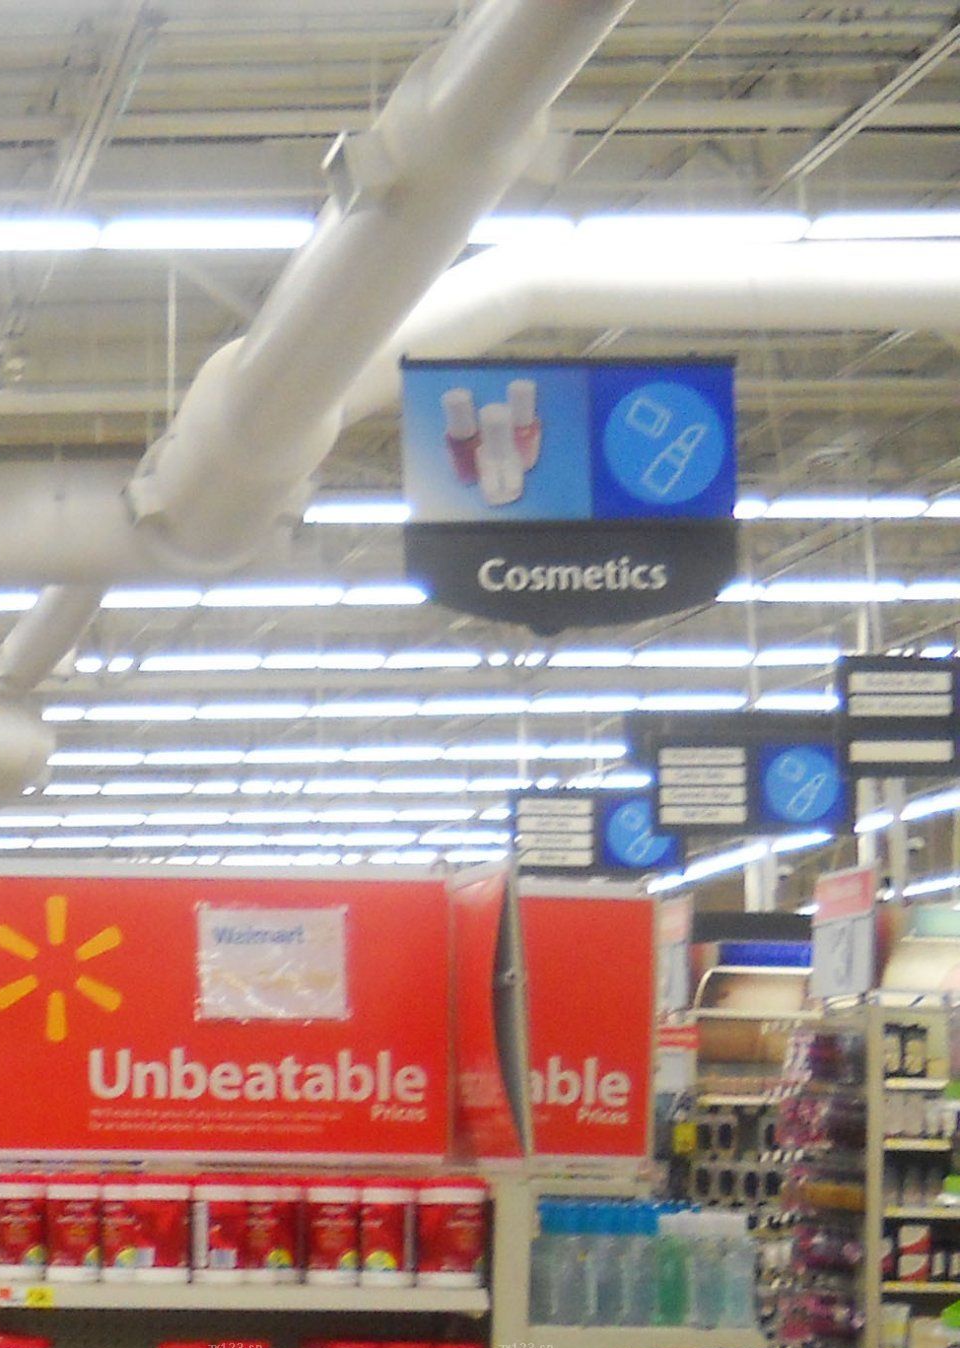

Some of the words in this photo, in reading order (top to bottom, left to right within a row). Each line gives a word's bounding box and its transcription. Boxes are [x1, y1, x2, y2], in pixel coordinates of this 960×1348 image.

[478, 556, 668, 592] Cosmetics
[213, 924, 304, 945] Walmart
[88, 1047, 428, 1103] Unbeatable
[370, 1103, 427, 1122] Prices
[577, 1106, 630, 1124] Prices
